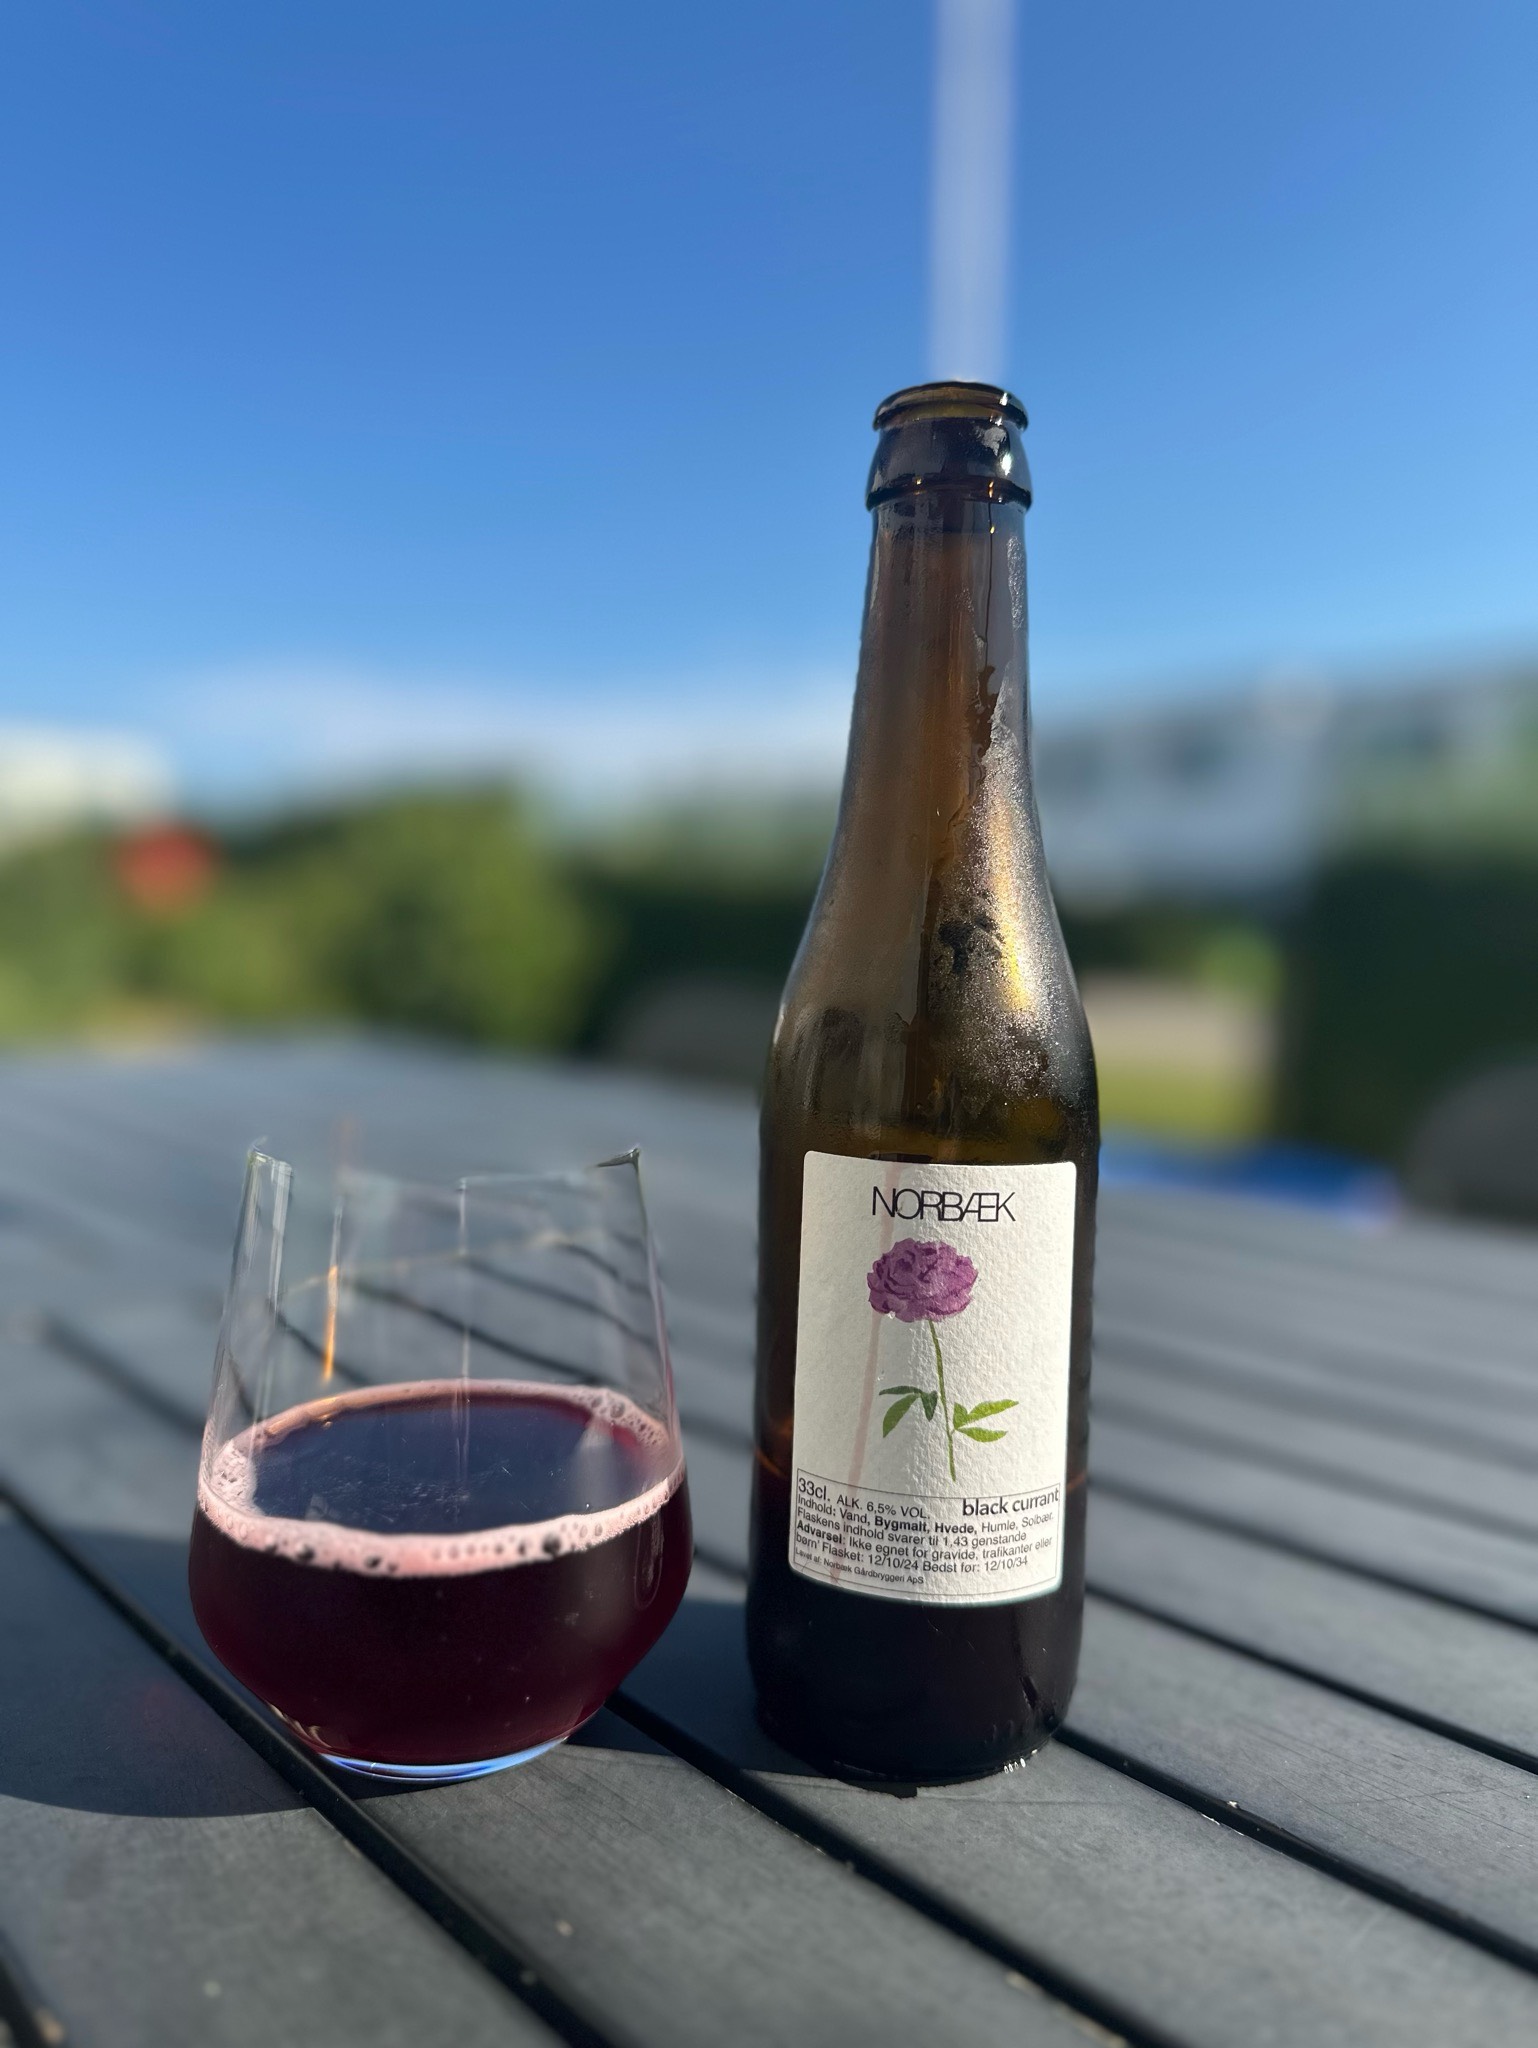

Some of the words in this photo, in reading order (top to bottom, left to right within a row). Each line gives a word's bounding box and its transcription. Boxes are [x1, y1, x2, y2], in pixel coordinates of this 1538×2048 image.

[872, 1186, 1016, 1222] NORBÆK
[797, 1493, 837, 1517] Indhold:
[839, 1508, 871, 1526] Vand,
[874, 1515, 930, 1533] Bygmalt,
[934, 1522, 978, 1535] Hvede,
[981, 1520, 1019, 1533] Humle,
[798, 1477, 831, 1502] 33cl.
[836, 1494, 863, 1510] ALK.
[866, 1501, 897, 1516] 6,5%
[900, 1505, 931, 1519] VOL.
[962, 1497, 1009, 1516] black
[1011, 1487, 1060, 1513] currant
[796, 1519, 846, 1546] Advarsel:
[849, 1537, 873, 1551] Ikke
[875, 1543, 909, 1557] egnet
[912, 1546, 929, 1559] for
[931, 1549, 979, 1562] gravide,
[982, 1541, 1033, 1559] trafikanter
[1034, 1535, 1053, 1550] eller
[797, 1506, 841, 1531] Flaskens
[843, 1521, 884, 1540] indhold
[887, 1532, 925, 1545] svarer
[928, 1535, 939, 1546] til
[943, 1536, 969, 1548] 1,43
[971, 1531, 1027, 1549] genstande
[821, 1541, 865, 1563] Flasket:
[868, 1554, 918, 1571] 12/10/24
[922, 1560, 958, 1573] Bedst
[960, 1561, 980, 1573] før:
[984, 1555, 1028, 1572] 12/10/34
[823, 1557, 853, 1573] Norbæk
[853, 1566, 905, 1583] Gårdbryggeri
[906, 1574, 925, 1585] ApS
